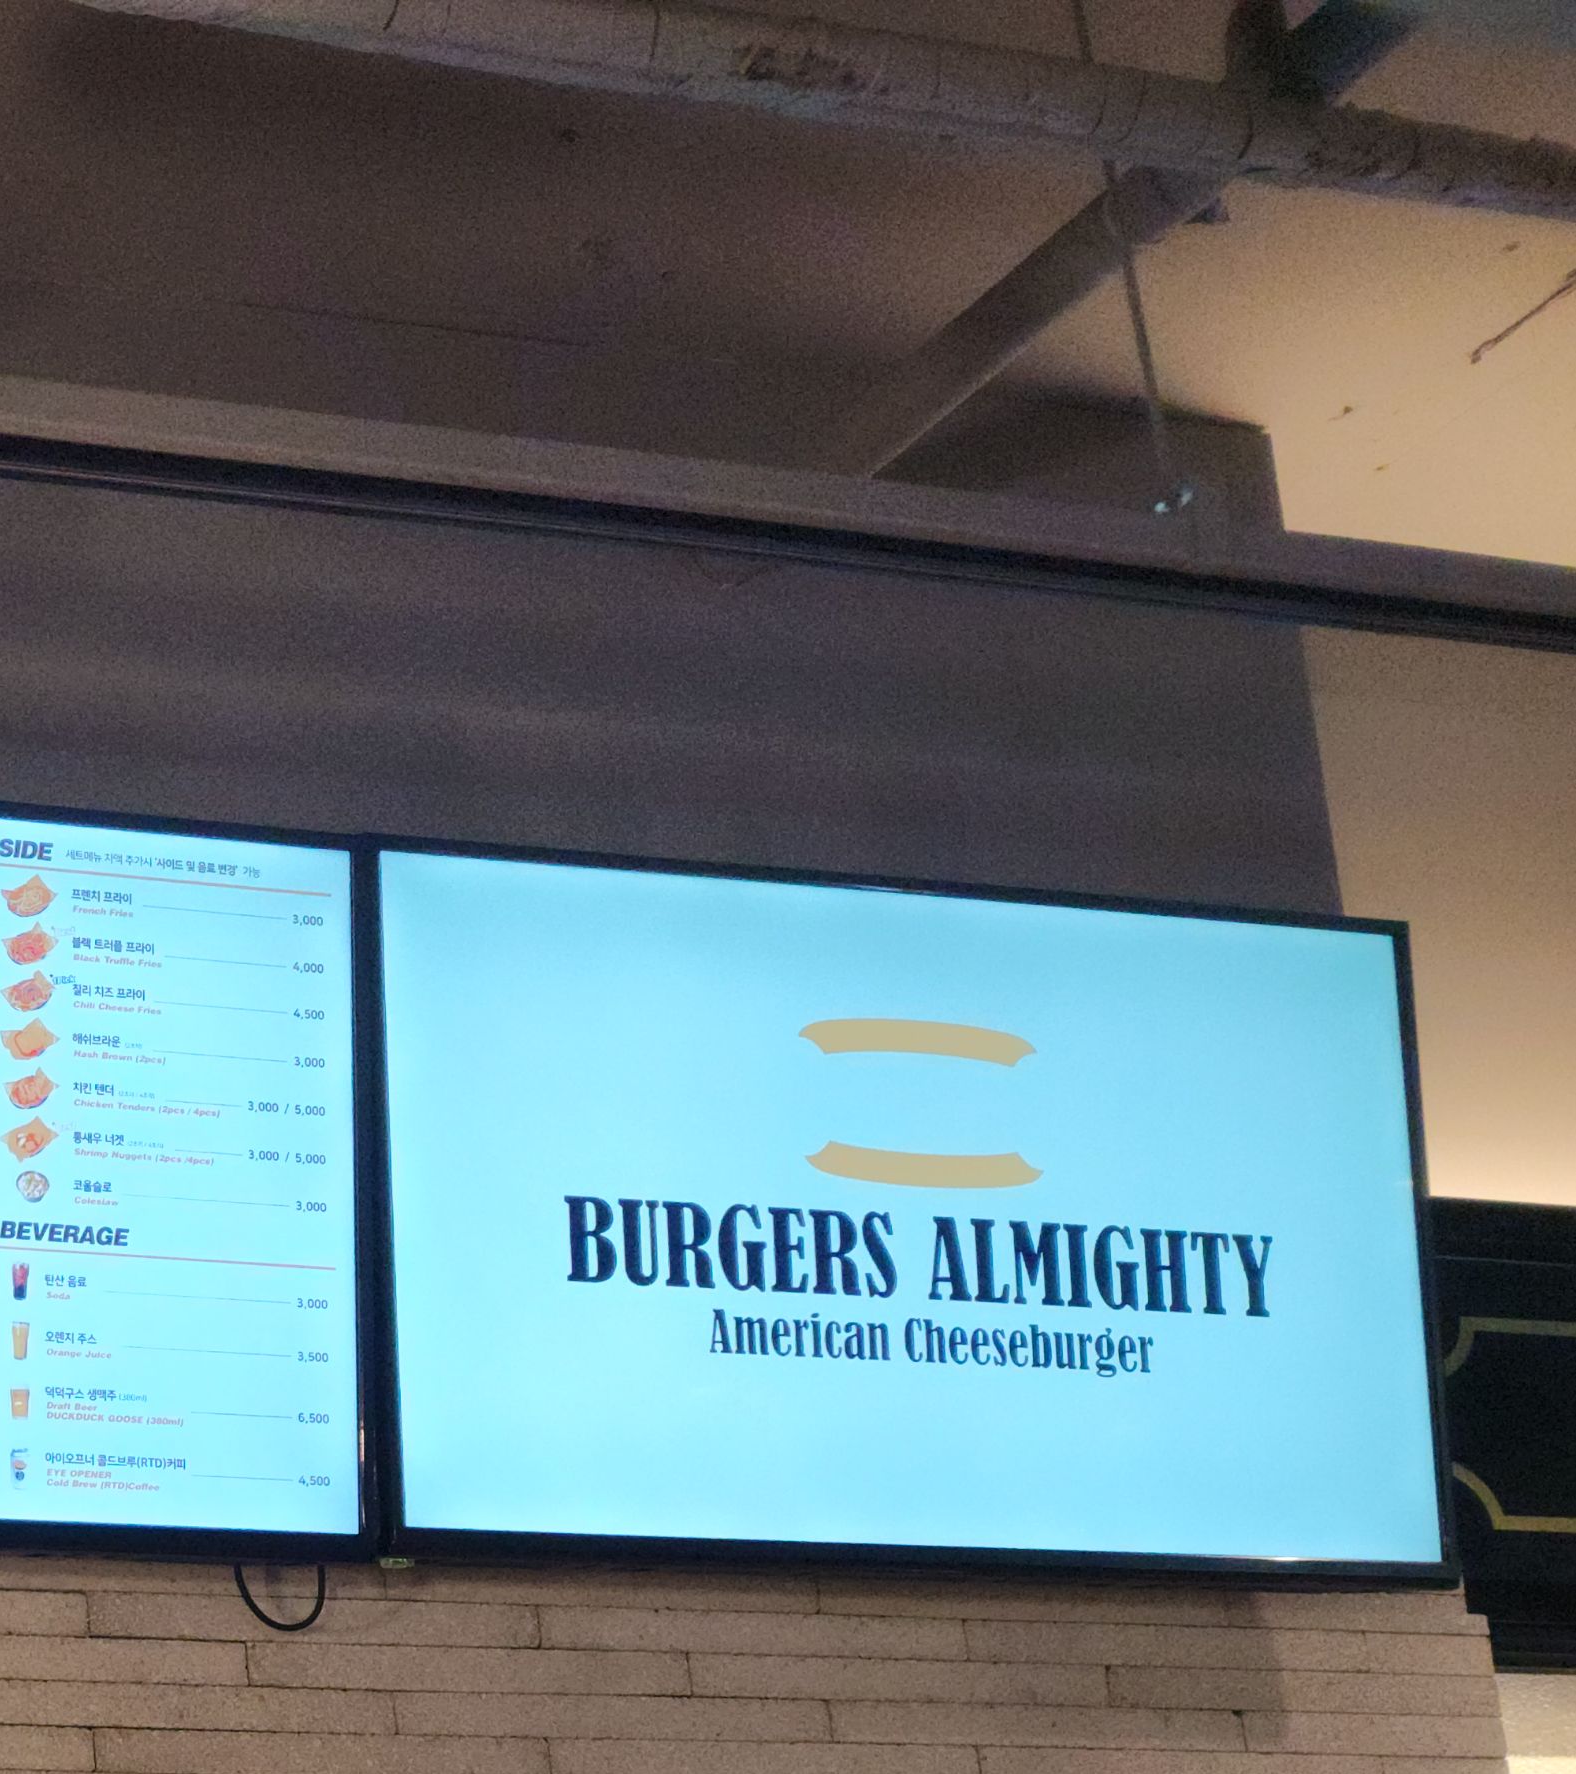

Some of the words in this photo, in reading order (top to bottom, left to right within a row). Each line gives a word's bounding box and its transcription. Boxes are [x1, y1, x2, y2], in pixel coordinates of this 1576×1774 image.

[242, 866, 261, 879] 가능
[71, 888, 101, 903] 프렌치
[103, 891, 132, 905] 프라이
[292, 914, 324, 928] 3,000
[94, 938, 123, 953] 트러플
[125, 941, 155, 955] 프라이
[292, 962, 325, 975] 4,000
[72, 984, 92, 998] 칠리
[94, 986, 114, 1000] 치즈
[117, 988, 146, 1002] 프라이
[293, 1008, 325, 1021] 4,500
[72, 1032, 121, 1048] 해쉬브라운
[294, 1056, 325, 1069] 3,000
[73, 1081, 92, 1095] 치킨
[94, 1083, 115, 1097] 텐더
[247, 1101, 279, 1114] 3,000
[294, 1104, 326, 1117] 5,000
[73, 1131, 102, 1145] 통새우
[105, 1133, 124, 1146] 너겟
[248, 1150, 280, 1162] 3,000
[295, 1152, 327, 1165] 5,000
[73, 1179, 113, 1193] 코울슬로
[296, 1201, 327, 1213] 3,000
[0, 1220, 130, 1247] BEVERAGE
[562, 1195, 898, 1300] BURGERS
[928, 1215, 1274, 1318] ALMIGHTY
[44, 1274, 65, 1288] 탄산
[67, 1275, 87, 1288] 음료
[296, 1298, 328, 1311] 3,000
[44, 1330, 75, 1344] 오렌지
[77, 1333, 97, 1346] 주스
[709, 1308, 892, 1363] American
[904, 1317, 1155, 1380] Cheeseburger
[297, 1351, 329, 1364] 3,500
[45, 1386, 85, 1400] 덕덕구스
[87, 1387, 117, 1402] 생맥주
[297, 1411, 330, 1425] 6,500
[45, 1452, 96, 1468] 아이오프너
[298, 1474, 331, 1488] 4,500
